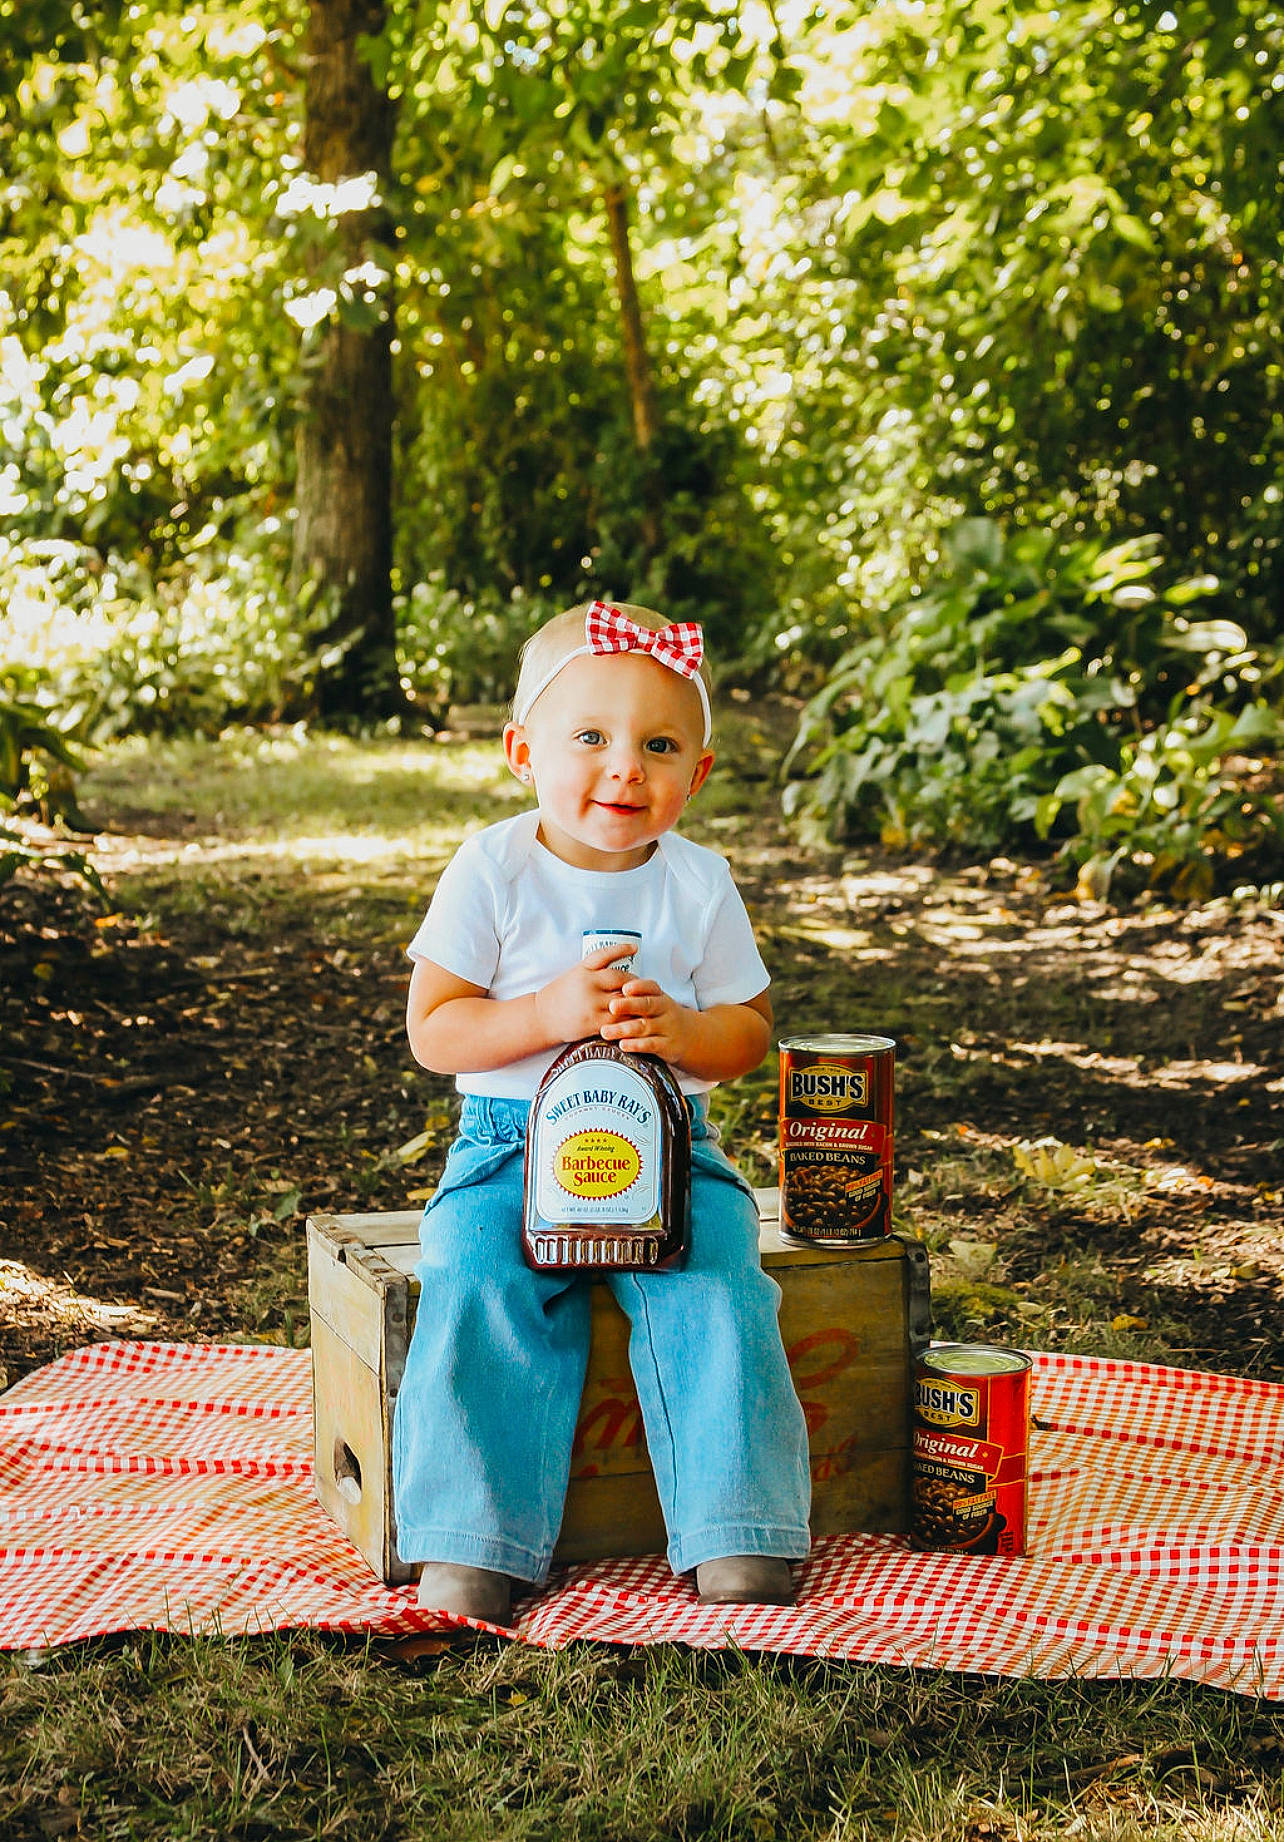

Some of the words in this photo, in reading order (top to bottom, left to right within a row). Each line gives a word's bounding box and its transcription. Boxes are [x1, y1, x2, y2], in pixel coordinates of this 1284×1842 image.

[791, 1072, 865, 1099] BUSH'S
[546, 1092, 581, 1125] SWEET
[583, 1089, 617, 1104] BABY
[618, 1094, 652, 1124] RAY'S
[808, 1098, 842, 1106] BEST
[789, 1121, 869, 1141] Original
[562, 1155, 631, 1170] Barbecue
[789, 1151, 824, 1162] BAKED
[825, 1152, 866, 1166] BEANS
[574, 1171, 617, 1186] Sauce
[924, 1410, 951, 1421] BEST
[935, 1465, 975, 1484] BEANS
